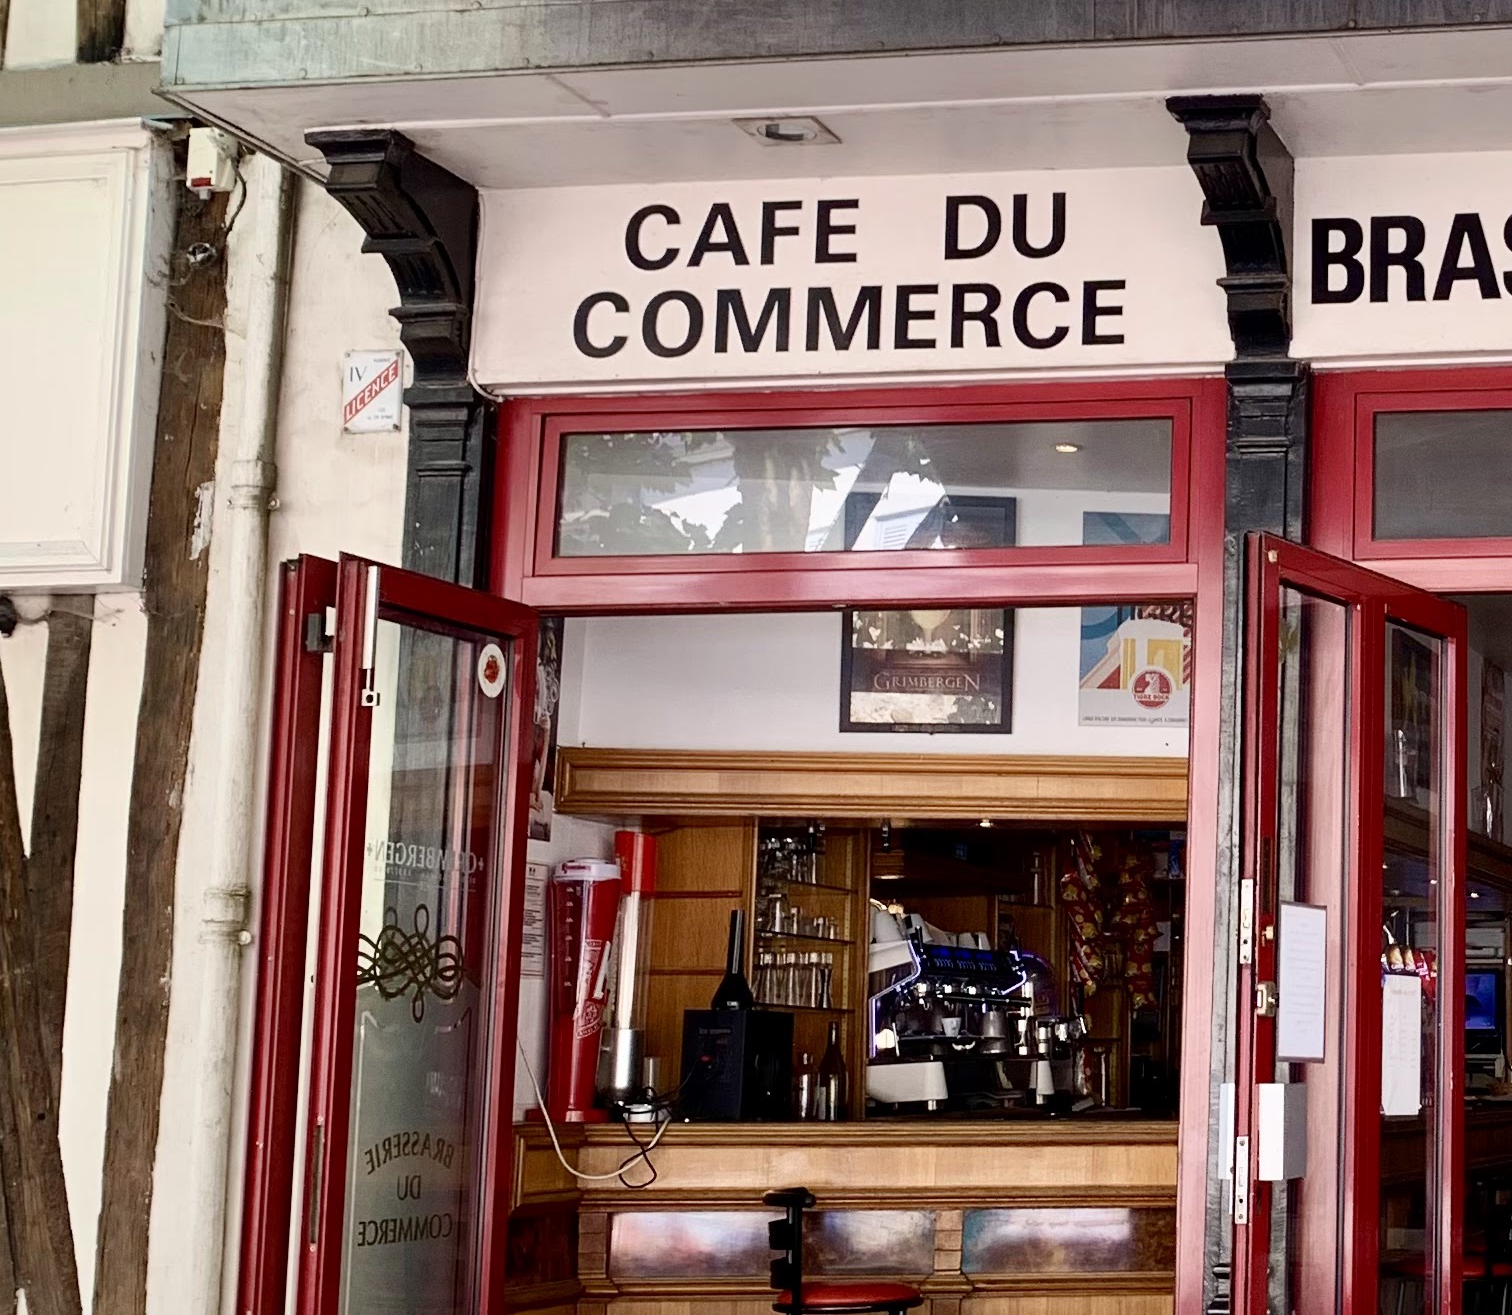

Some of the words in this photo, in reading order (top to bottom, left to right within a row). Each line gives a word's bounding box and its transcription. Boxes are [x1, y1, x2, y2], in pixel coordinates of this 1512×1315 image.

[623, 197, 861, 271] CAFE
[944, 191, 1069, 262] DU
[572, 278, 1127, 360] COMMERCE
[345, 363, 397, 424] LICENCE
[349, 366, 367, 382] IV
[873, 671, 981, 692] GRIMBERGEN
